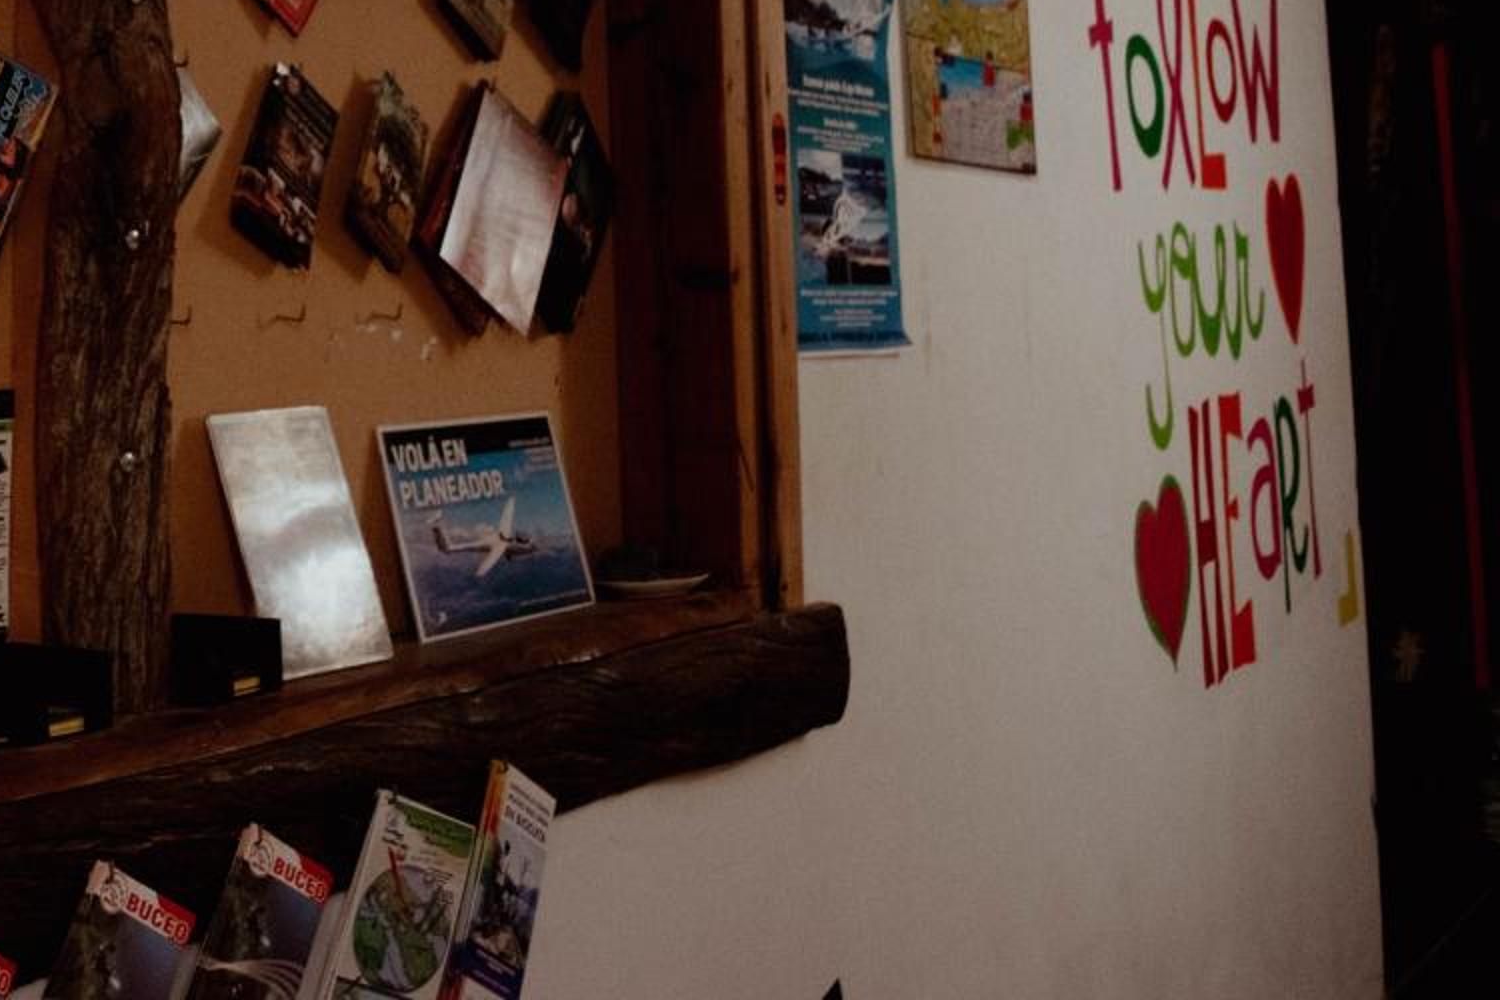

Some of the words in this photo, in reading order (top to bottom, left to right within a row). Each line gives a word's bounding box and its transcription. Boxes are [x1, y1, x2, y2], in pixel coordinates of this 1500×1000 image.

[390, 433, 443, 473] VOLÁ
[441, 437, 469, 468] EN
[399, 468, 506, 509] PLANEADOR
[273, 856, 327, 901] BUCEO
[126, 892, 189, 942] BUCEO
